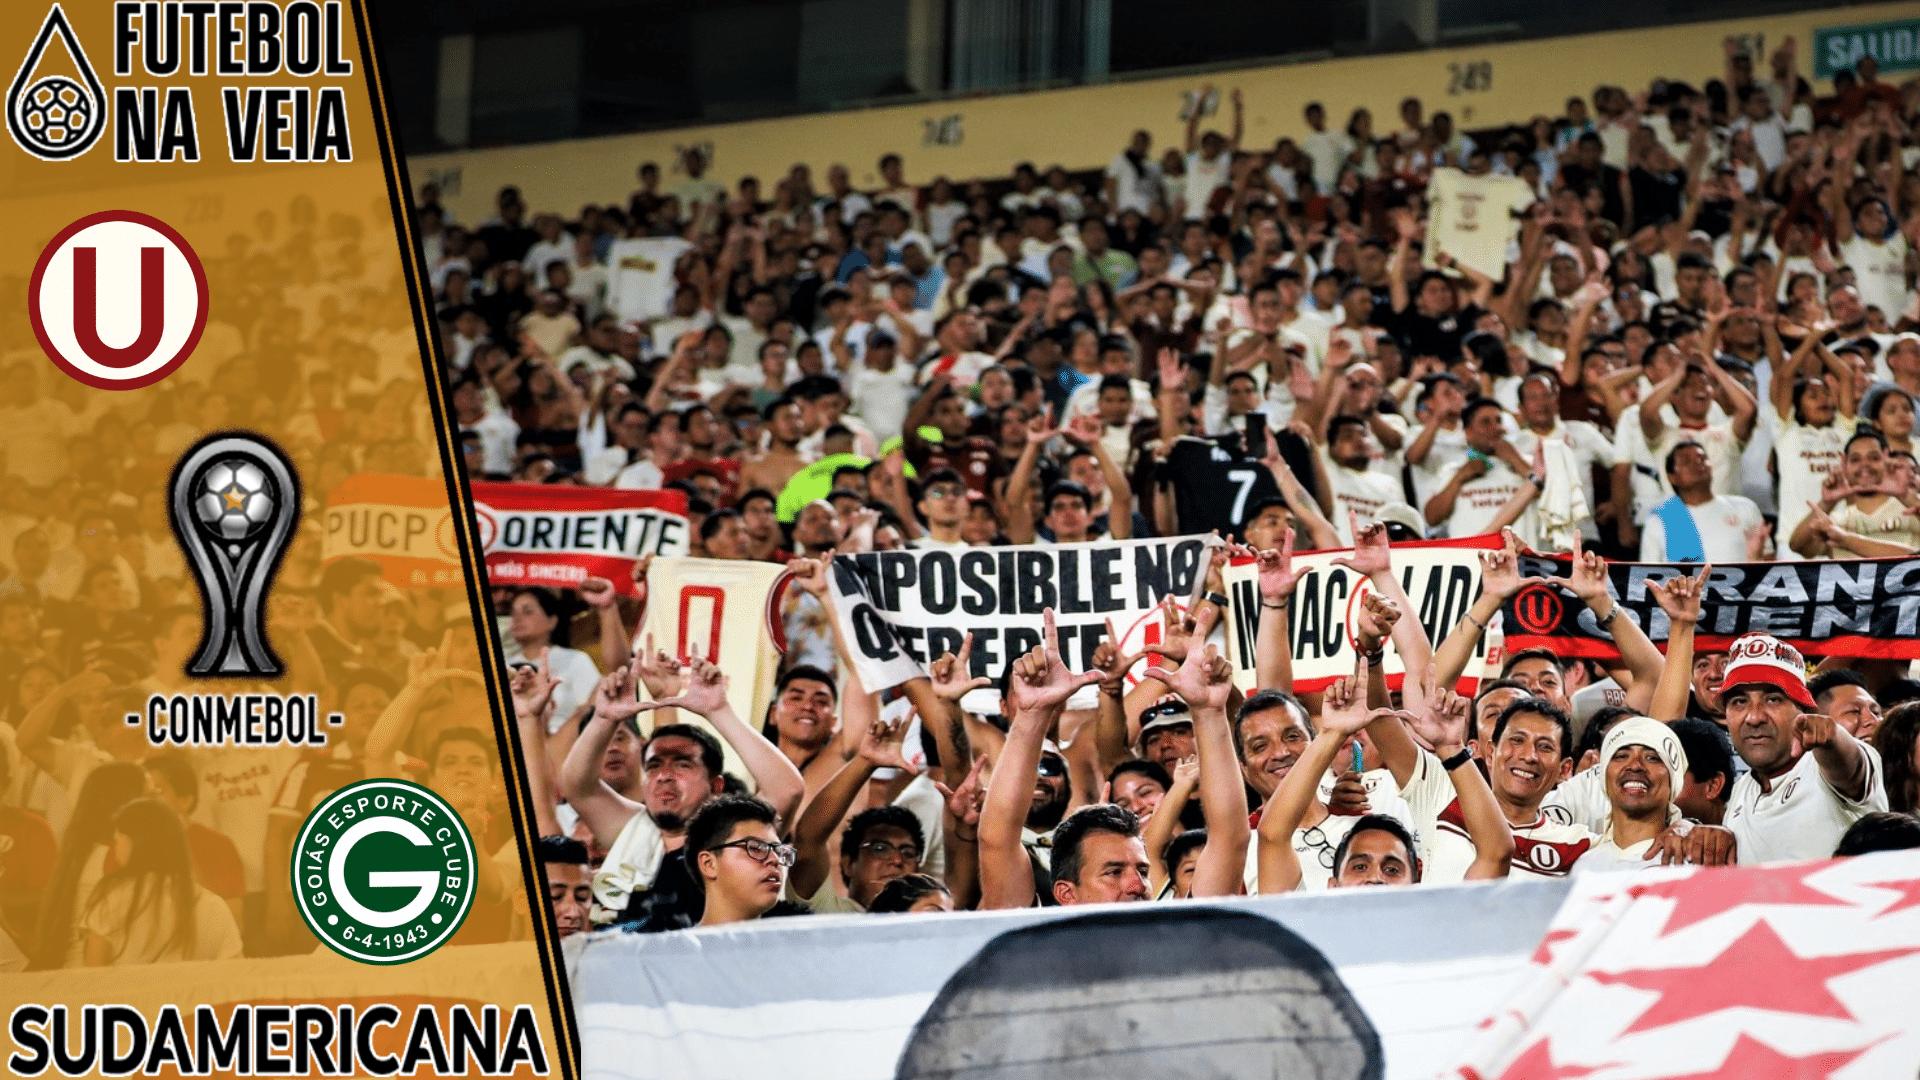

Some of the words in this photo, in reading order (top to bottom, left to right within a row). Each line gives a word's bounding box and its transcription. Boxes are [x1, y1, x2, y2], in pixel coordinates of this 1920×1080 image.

[1827, 29, 1920, 68] SALID
[1228, 469, 1257, 525] 7
[504, 514, 685, 558] ORIENTE
